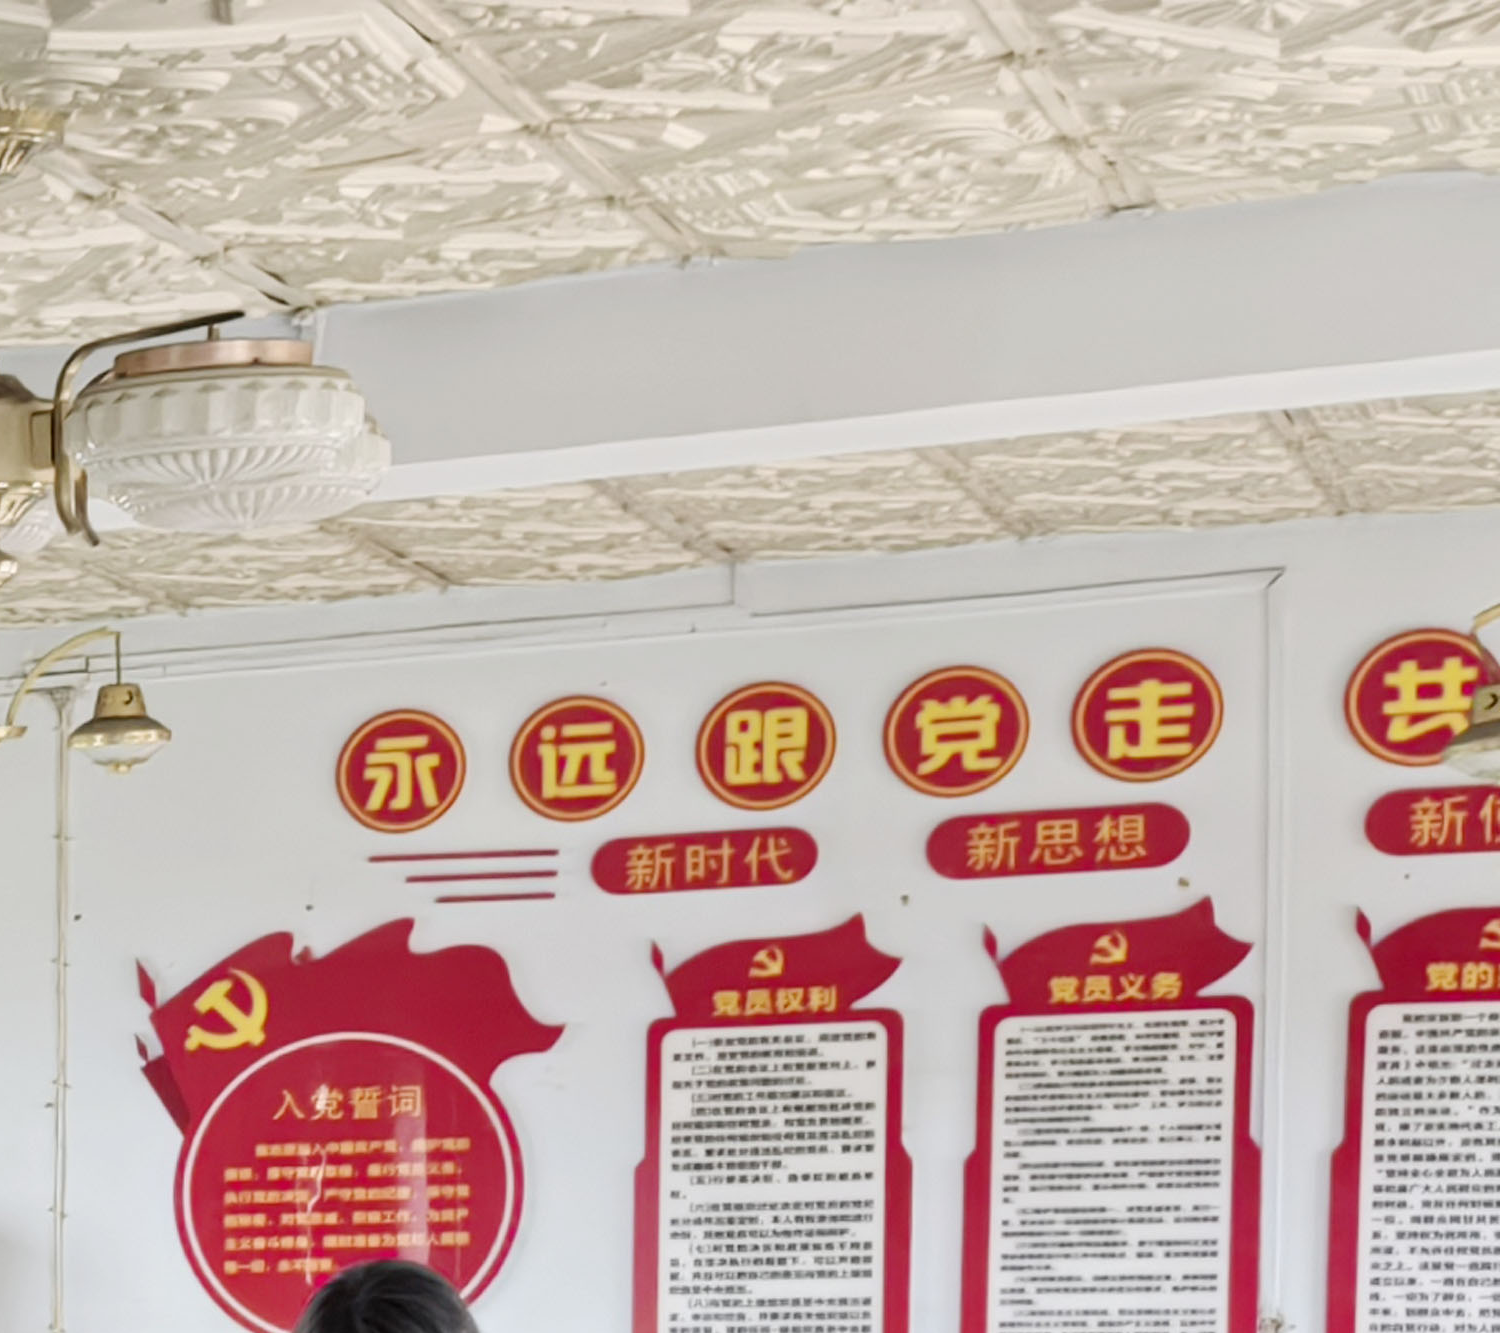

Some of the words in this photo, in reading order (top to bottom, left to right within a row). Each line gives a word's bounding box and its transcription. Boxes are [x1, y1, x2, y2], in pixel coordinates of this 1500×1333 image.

[1382, 656, 1478, 743] 共
[362, 677, 1196, 810] 永远跟党走
[624, 836, 802, 890] 新时代
[964, 811, 1149, 873] 新思想
[1048, 972, 1183, 1003] 党员义务
[1425, 962, 1500, 991] 党的
[712, 985, 838, 1017] 党员权利
[272, 1083, 423, 1121] 入党誓词
